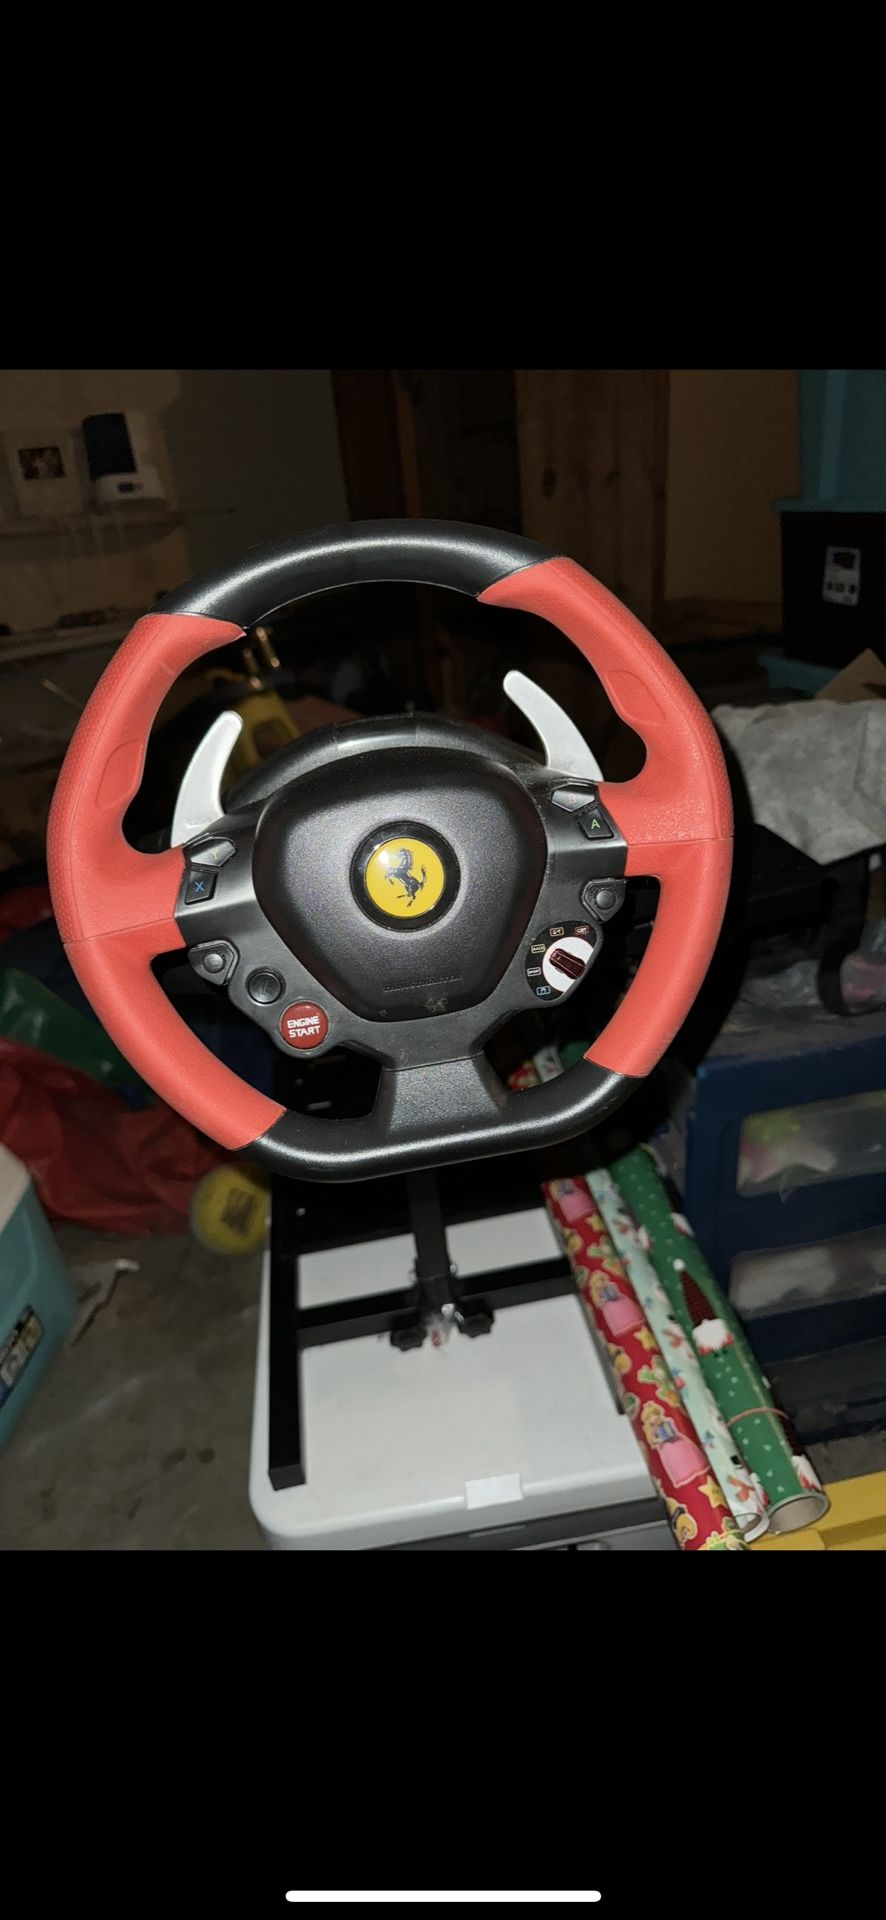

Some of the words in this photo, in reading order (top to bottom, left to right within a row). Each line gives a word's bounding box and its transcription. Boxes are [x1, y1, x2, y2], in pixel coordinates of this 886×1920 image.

[591, 819, 600, 829] A
[195, 881, 204, 892] X
[287, 1016, 320, 1028] ENGINE
[289, 1025, 320, 1038] START
